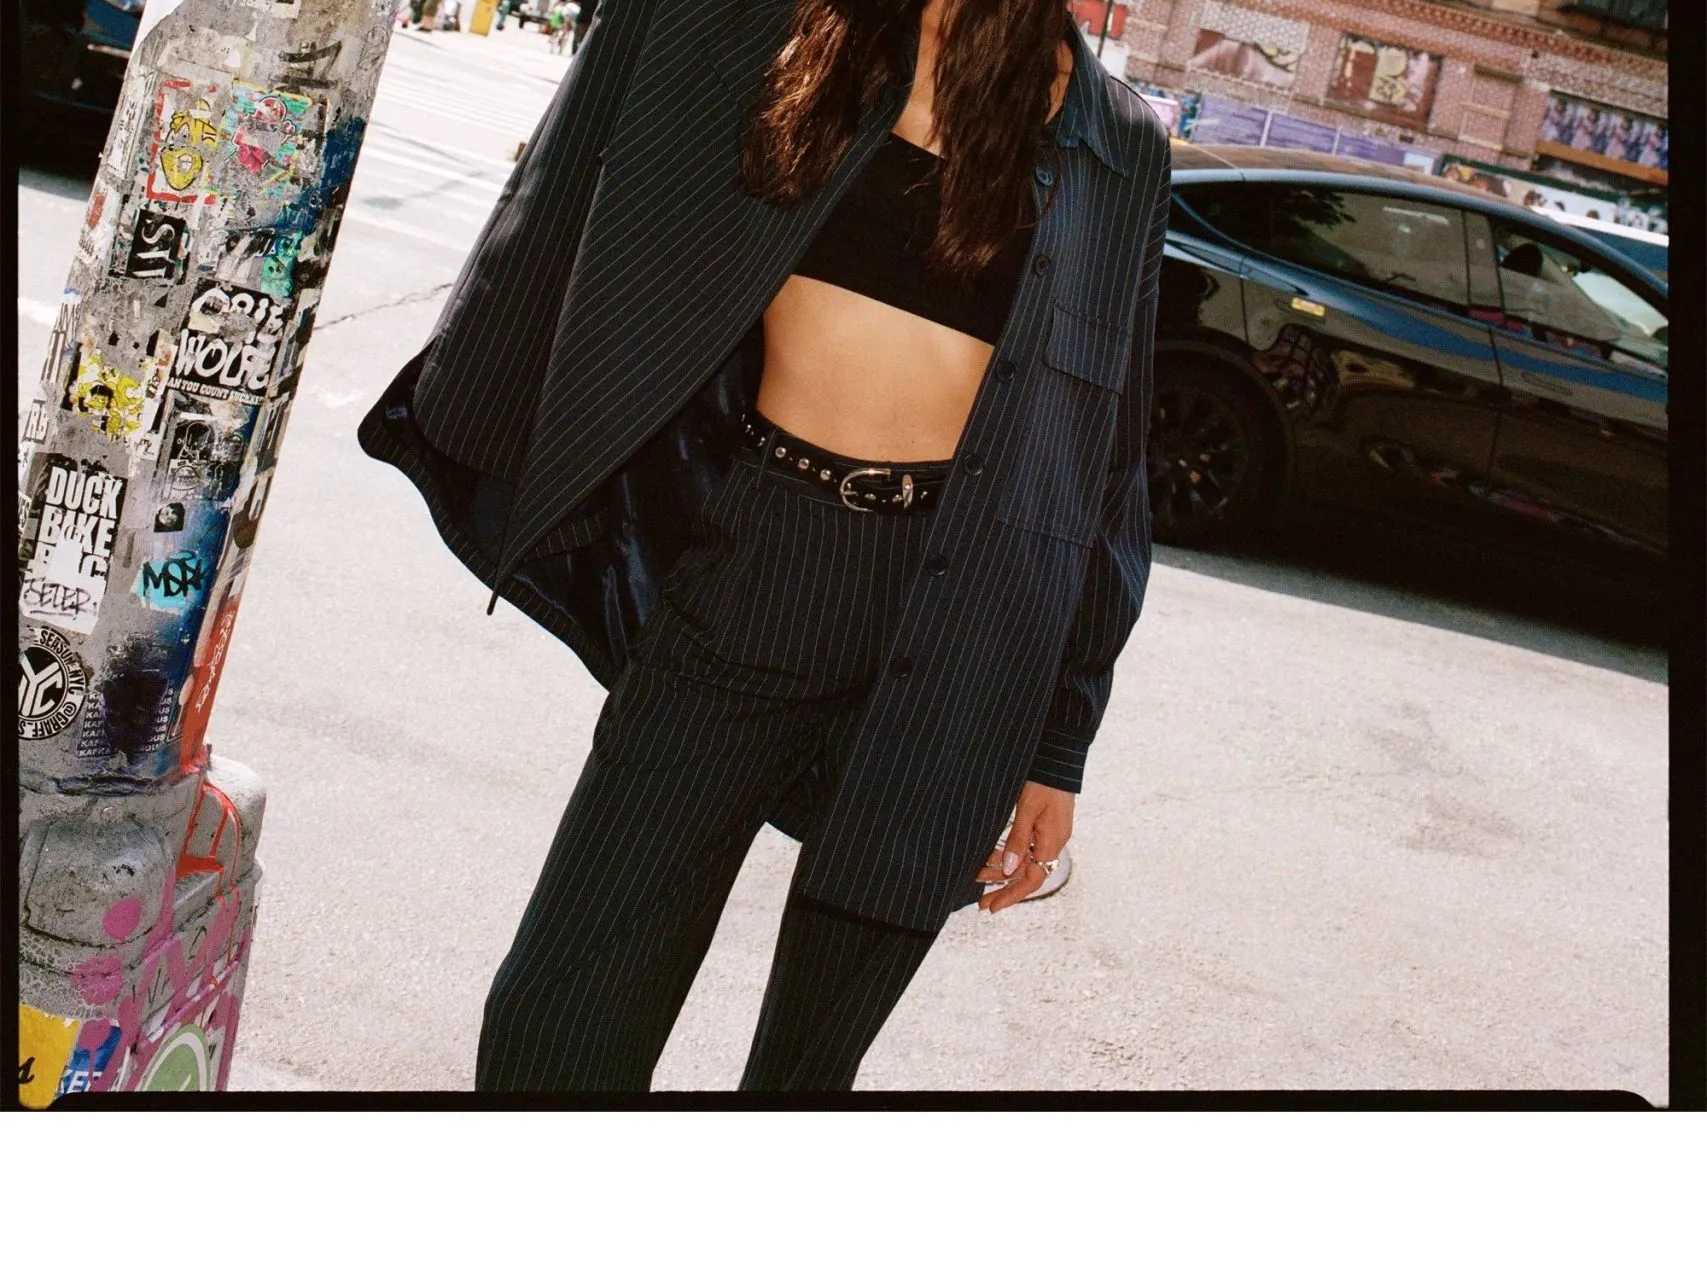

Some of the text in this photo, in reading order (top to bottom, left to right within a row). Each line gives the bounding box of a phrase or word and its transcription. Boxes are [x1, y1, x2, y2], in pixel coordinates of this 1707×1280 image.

[168, 377, 182, 390] AN
[182, 379, 199, 394] YOU
[199, 383, 230, 399] COUNT
[45, 466, 123, 519] DUCK
